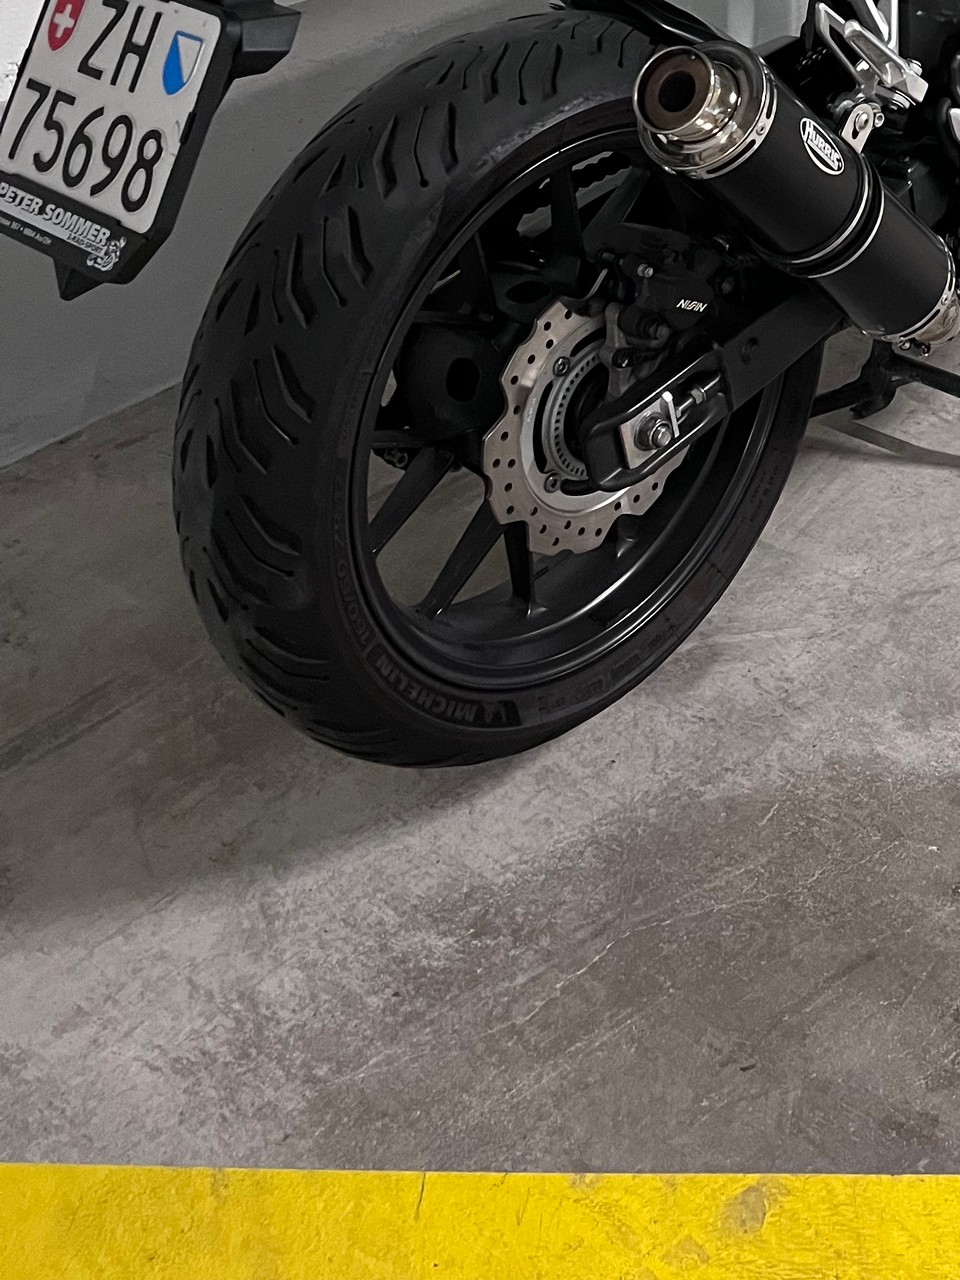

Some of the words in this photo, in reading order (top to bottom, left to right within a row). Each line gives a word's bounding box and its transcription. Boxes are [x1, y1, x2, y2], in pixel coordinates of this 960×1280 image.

[8, 77, 164, 214] 75698
[803, 119, 842, 171] HURRIC
[0, 181, 43, 216] PETER
[42, 203, 111, 248] SOMMER
[375, 655, 480, 723] MICHELIN
